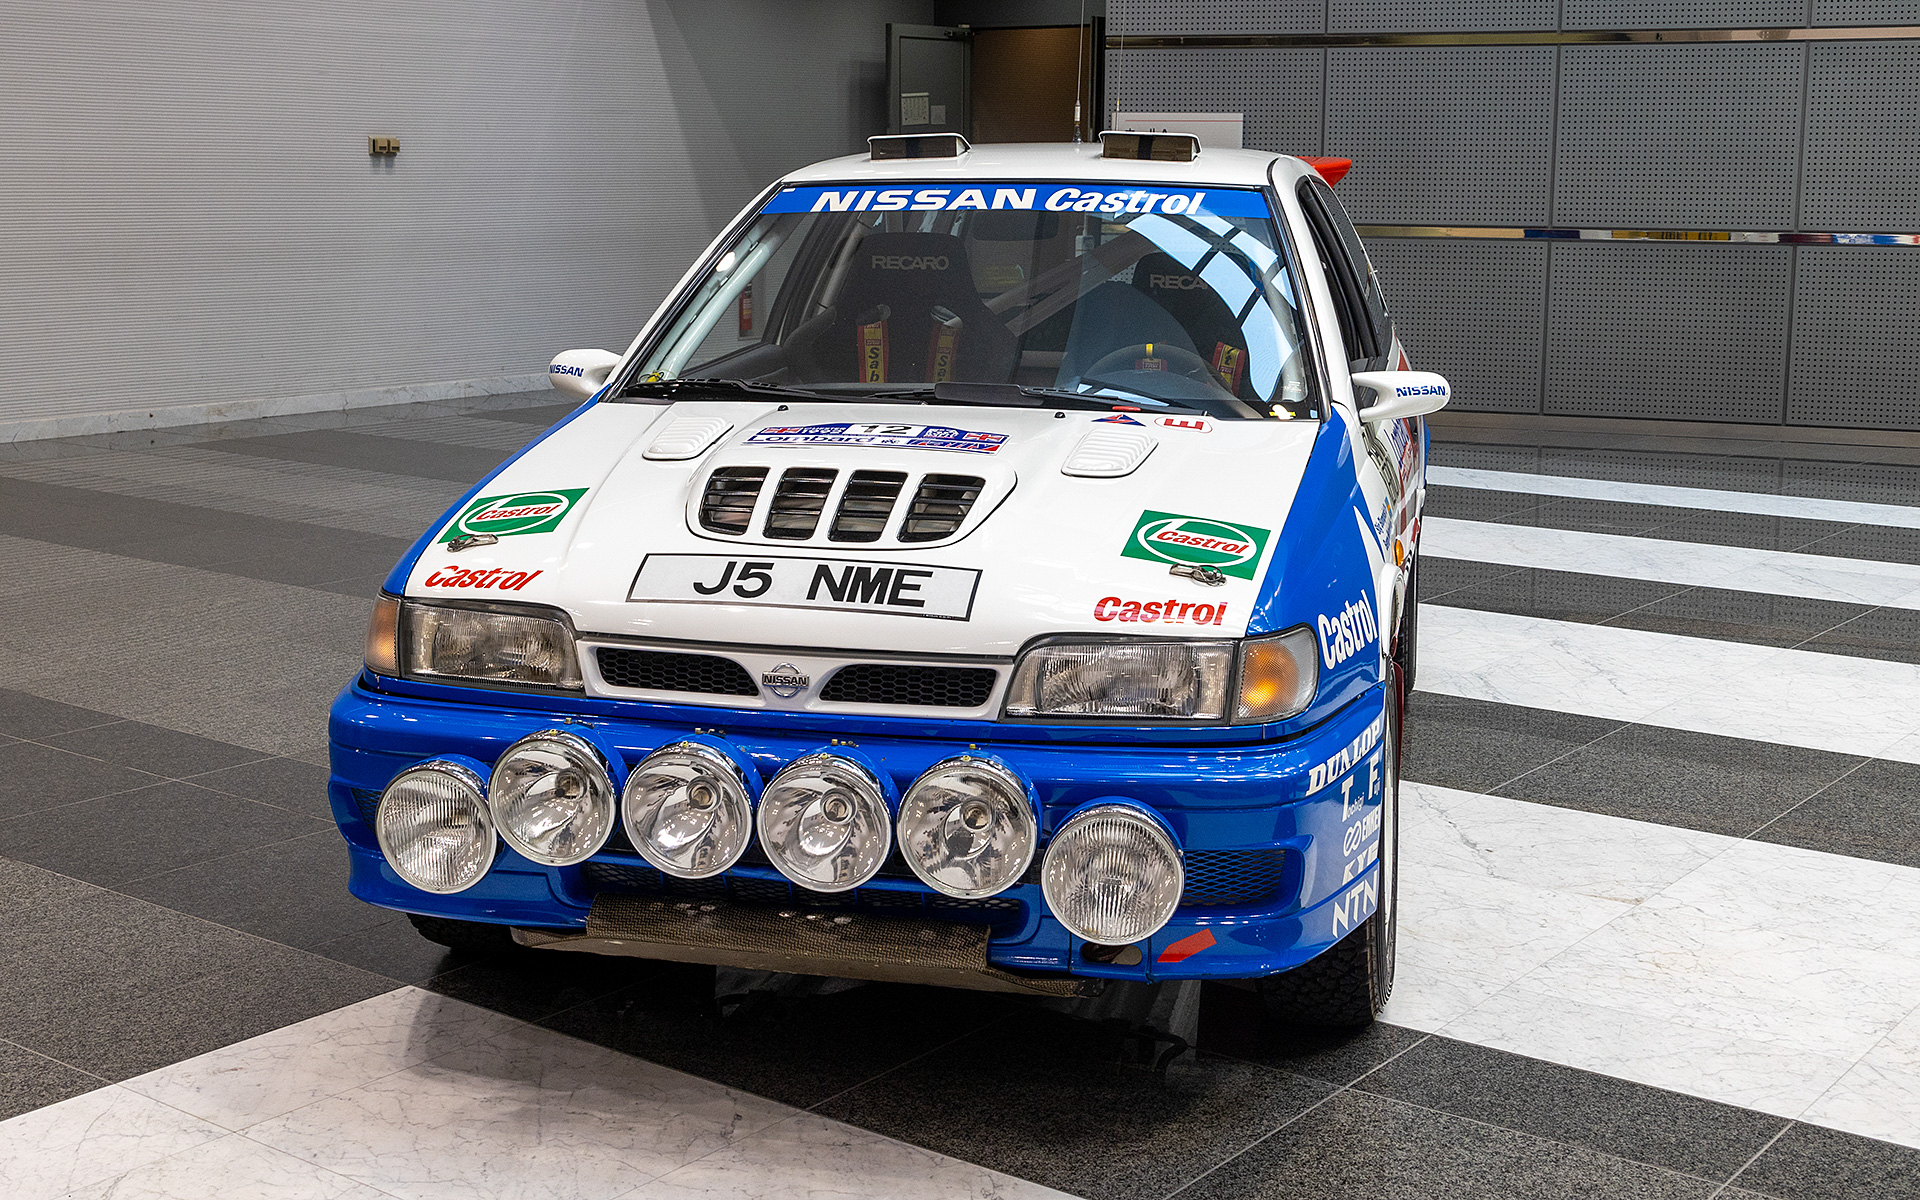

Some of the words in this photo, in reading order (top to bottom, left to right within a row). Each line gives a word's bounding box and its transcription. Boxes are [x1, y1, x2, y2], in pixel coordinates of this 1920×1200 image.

[810, 188, 1037, 213] NISSAN
[1045, 188, 1206, 215] Castrol
[871, 255, 949, 271] RECARO
[549, 364, 584, 377] NISSAN
[1396, 385, 1446, 397] NISSAN
[747, 435, 875, 443] Lombard
[861, 424, 909, 434] 12
[476, 504, 561, 520] Castrol
[1157, 531, 1249, 554] Castrol
[425, 566, 544, 591] Castrol
[693, 561, 775, 598] J5
[806, 564, 934, 608] NME
[1094, 597, 1228, 625] Castrol
[1318, 589, 1378, 670] Castrol
[764, 675, 807, 685] NISSAN
[1306, 718, 1380, 797] DUNLOP
[1333, 870, 1378, 939] NTN
